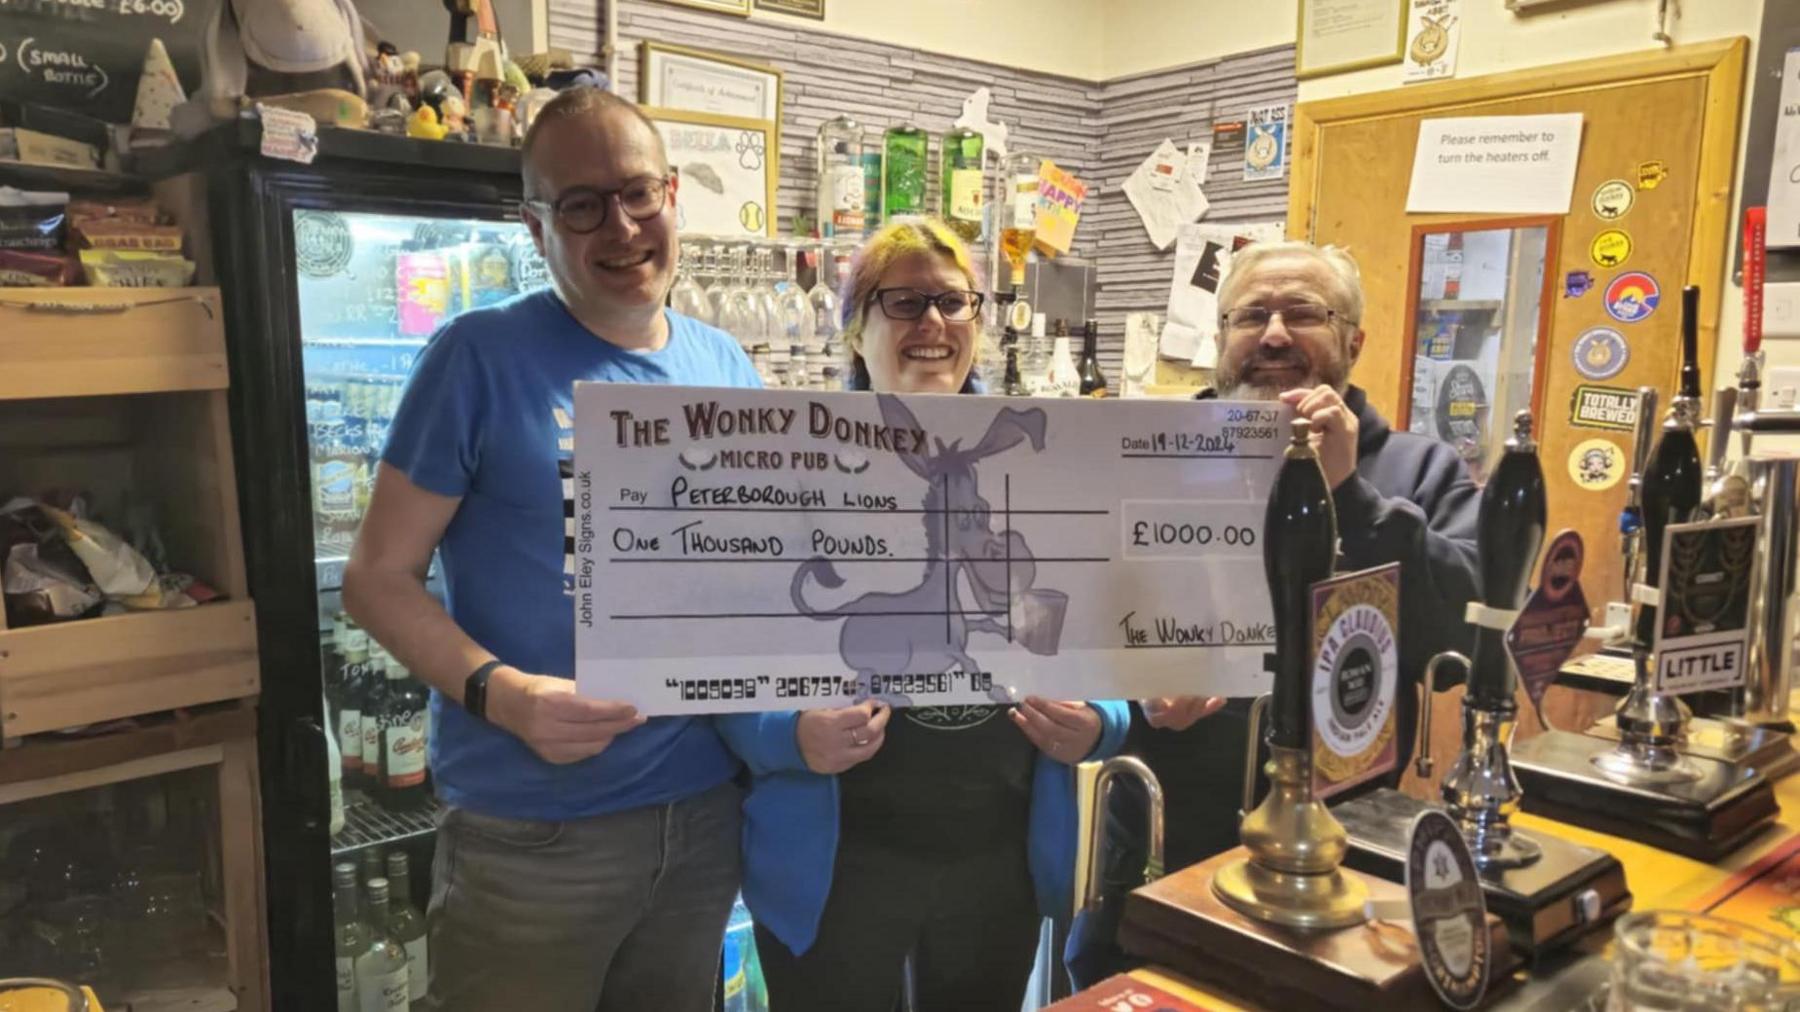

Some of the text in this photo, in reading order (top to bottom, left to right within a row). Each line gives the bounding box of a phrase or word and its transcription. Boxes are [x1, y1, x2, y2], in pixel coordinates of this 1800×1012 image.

[1440, 131, 1555, 145] Please remember to
[1438, 150, 1550, 164] turn the heaters off.
[1580, 405, 1635, 424] BREWED
[1584, 392, 1637, 411] TOTALLY
[610, 401, 929, 453] THE WONKY DONKEY
[1227, 409, 1279, 422] 20-67-37
[1121, 432, 1235, 453] Date 19-12-2024
[720, 450, 829, 471] MICRO PUB
[620, 476, 898, 510] Pay PETERBOROUGH LIONS
[672, 520, 784, 557] THOUSAND
[812, 529, 894, 557] POUNDS.
[1133, 521, 1256, 547] £1000.00
[578, 471, 595, 628] John Eley Signs.co.uk
[1119, 611, 1277, 644] THE WONKY DONKE
[1319, 608, 1393, 673] IPA CLAUDIUS
[1666, 651, 1735, 679] LITTLE
